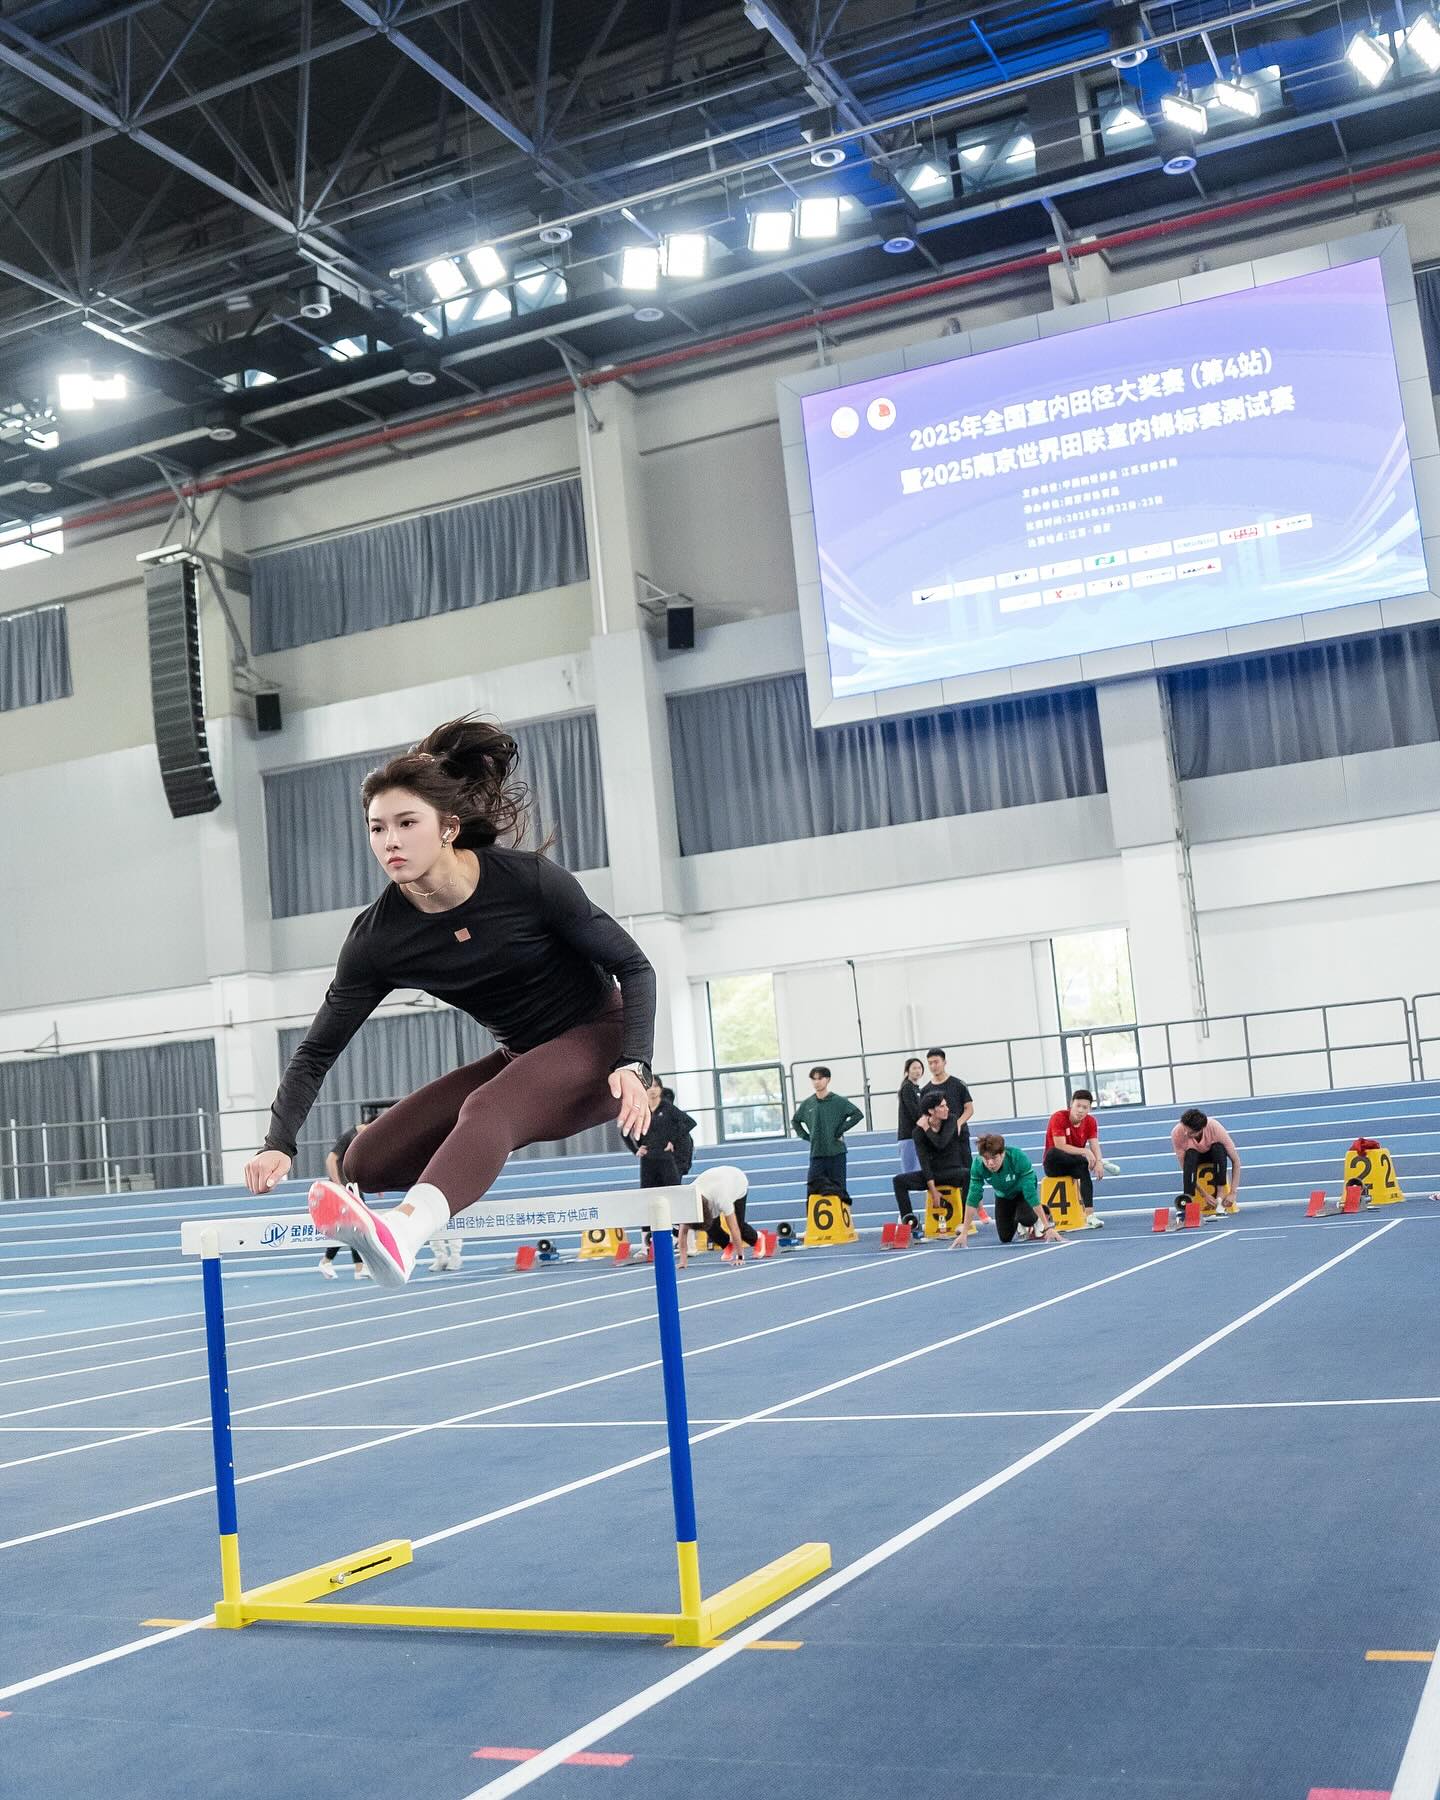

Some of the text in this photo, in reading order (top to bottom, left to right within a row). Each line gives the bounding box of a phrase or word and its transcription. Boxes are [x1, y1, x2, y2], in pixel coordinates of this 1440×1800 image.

[1199, 1167, 1218, 1200] 3
[1350, 1156, 1373, 1189] 2
[1381, 1154, 1396, 1188] 2
[813, 1198, 834, 1231] 6
[931, 1190, 954, 1222] 5
[1047, 1181, 1071, 1215] 4
[441, 1207, 600, 1231] 国田径协会田径器材类官方供应商
